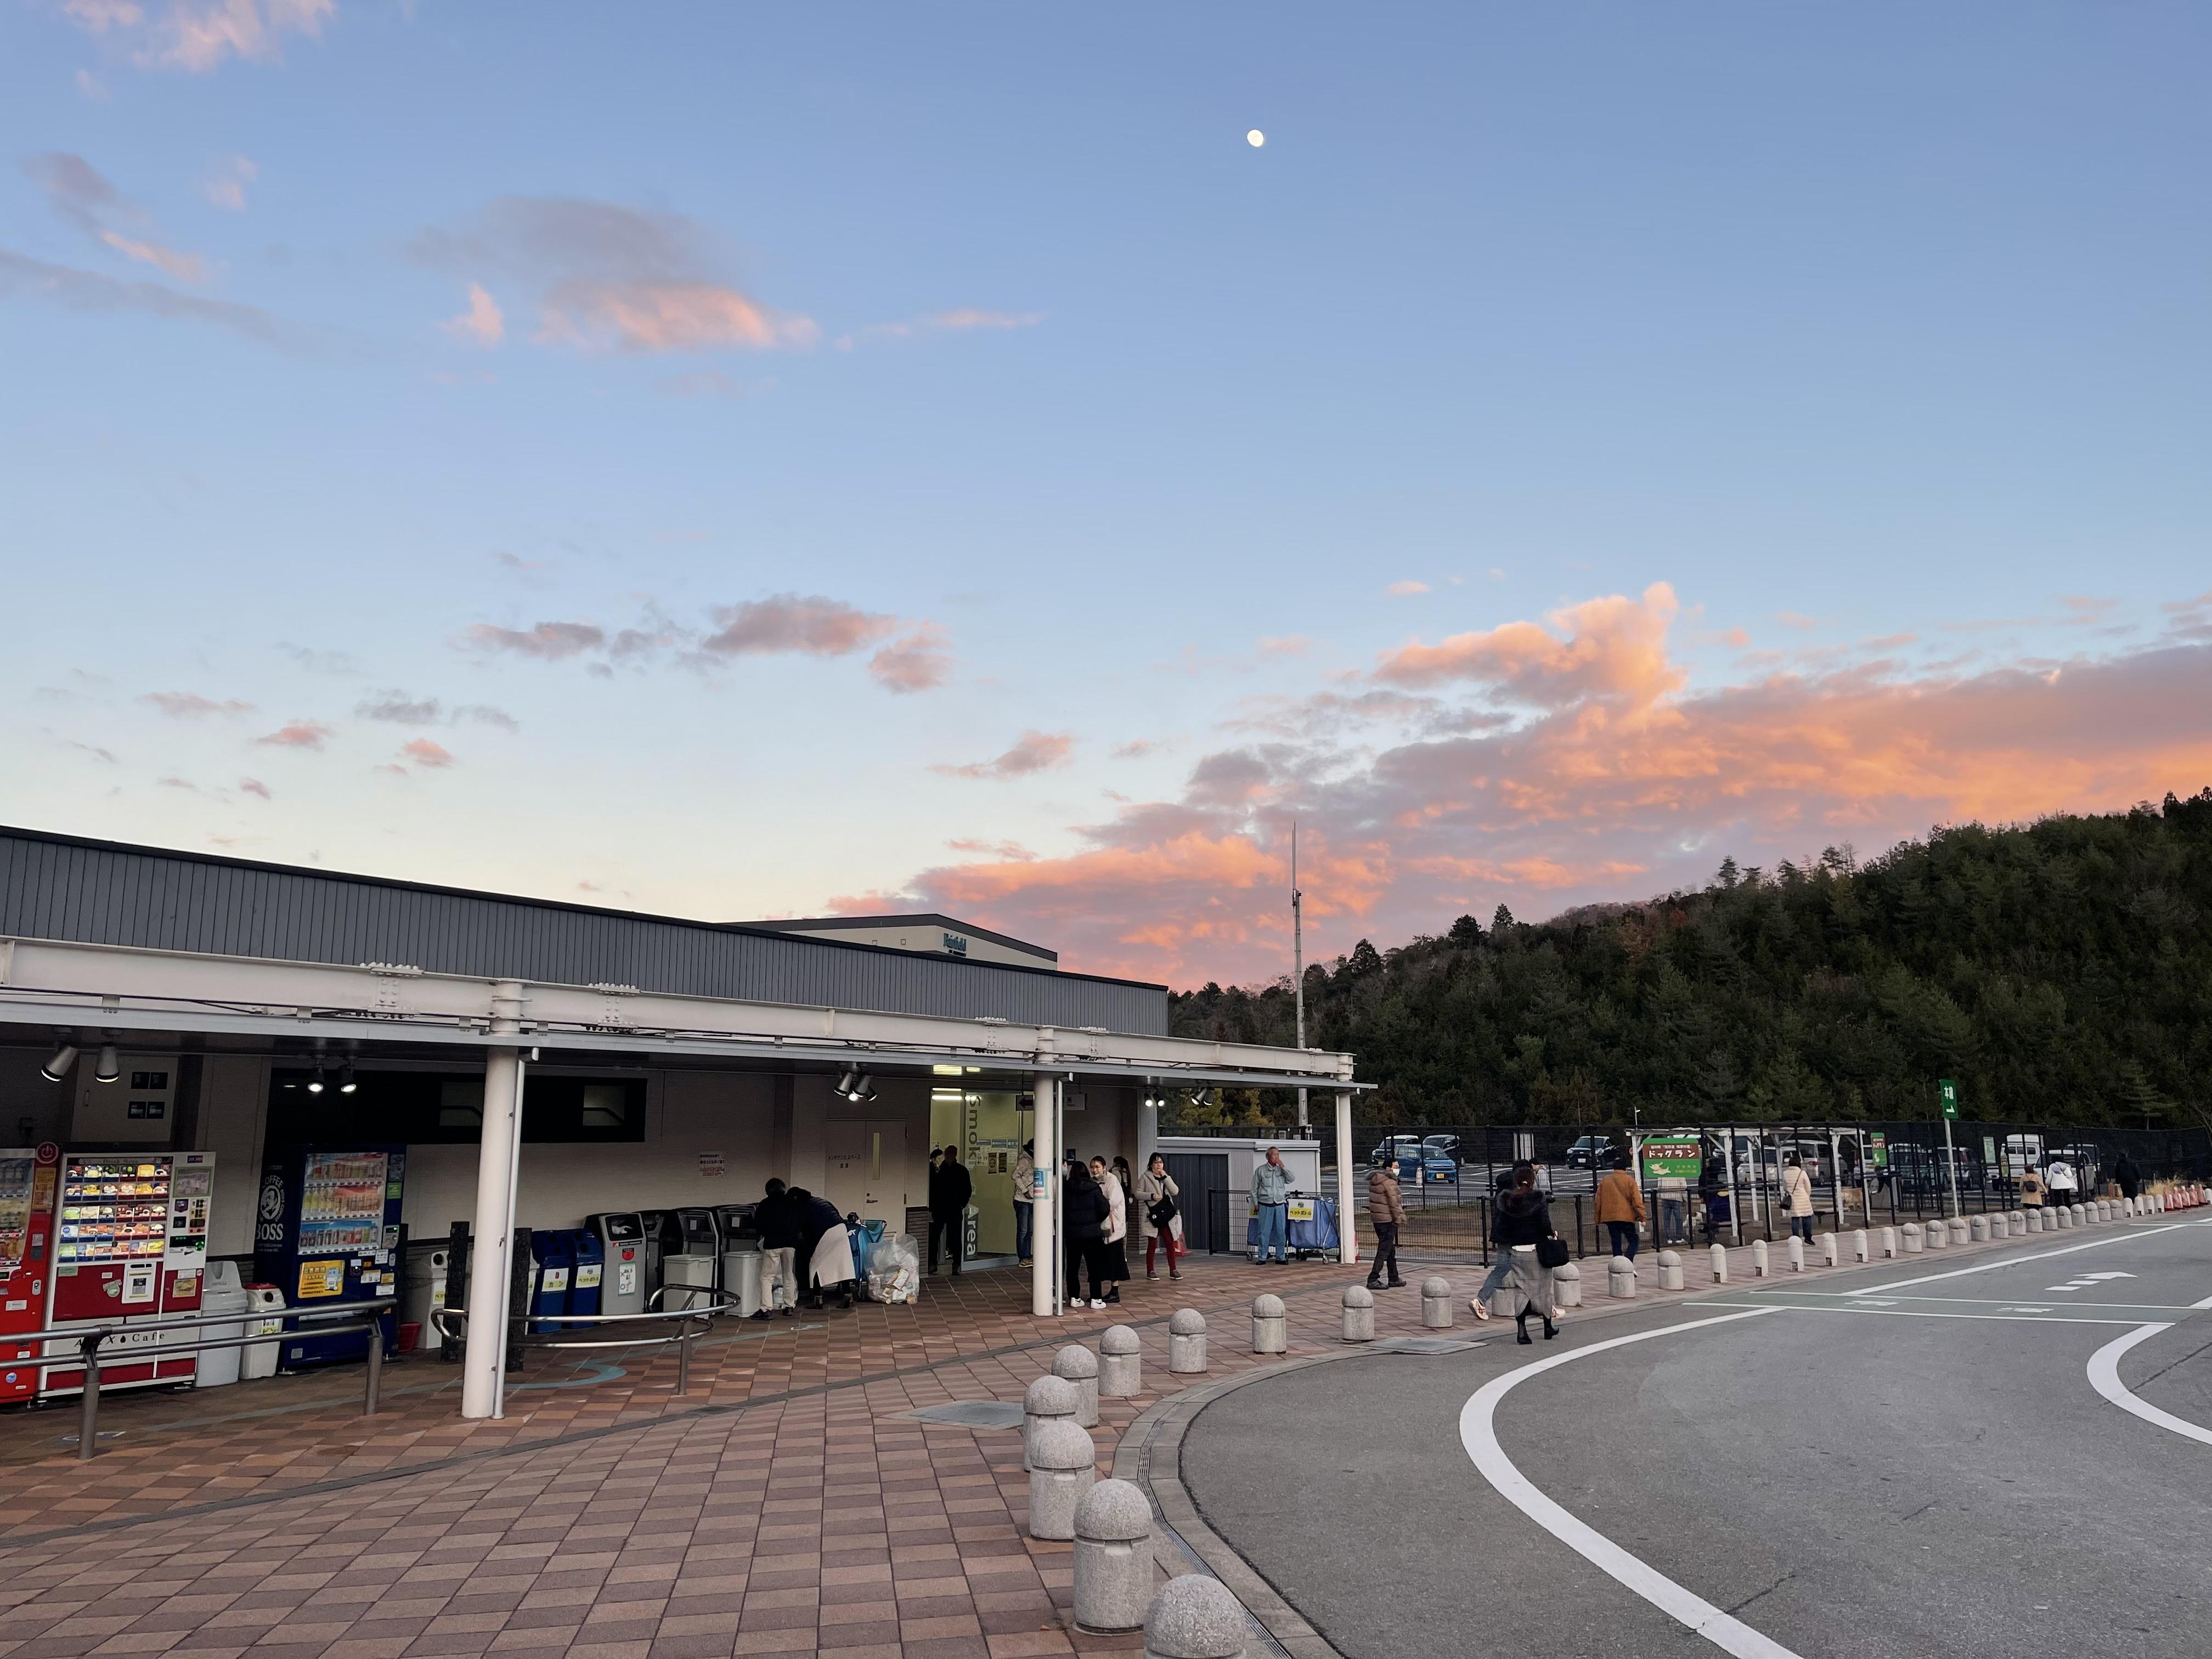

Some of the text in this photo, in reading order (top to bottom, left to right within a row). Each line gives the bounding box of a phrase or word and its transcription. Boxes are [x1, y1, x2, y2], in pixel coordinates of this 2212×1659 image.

[1649, 1150, 1695, 1158] ドッグラン
[256, 1223, 284, 1241] BOSS
[966, 1204, 979, 1256] Area
[75, 1332, 165, 1348] AX Cafe
